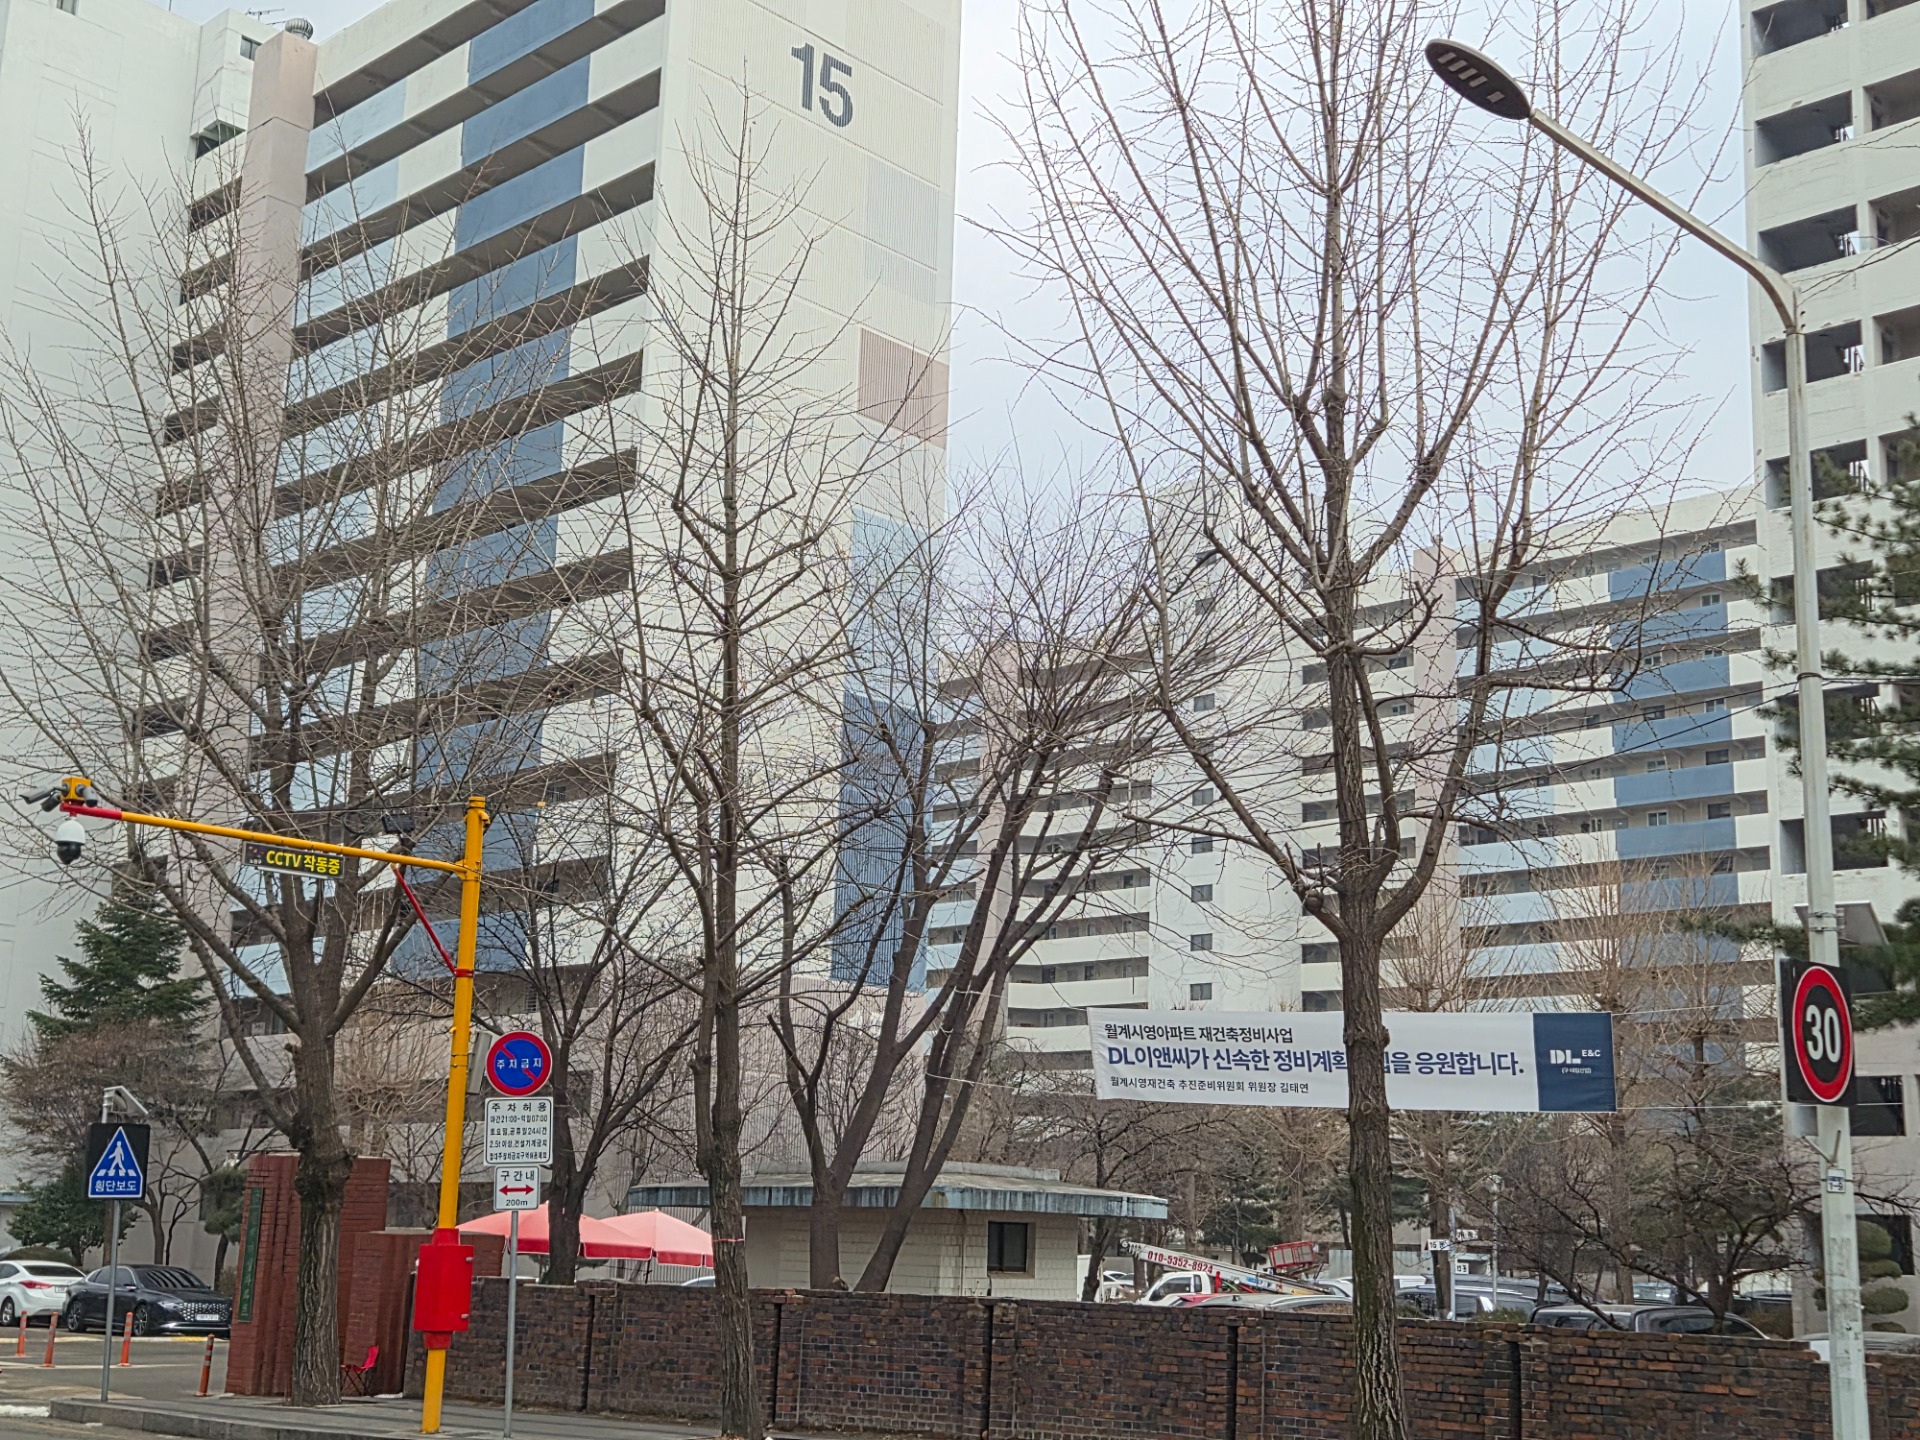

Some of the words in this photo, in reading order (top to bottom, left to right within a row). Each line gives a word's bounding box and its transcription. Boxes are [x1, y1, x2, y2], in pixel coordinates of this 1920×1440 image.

[791, 42, 853, 127] 15
[266, 850, 301, 867] CCTV
[304, 855, 340, 875] 작동중
[1105, 1023, 1197, 1041] 월계시영아파트
[1199, 1026, 1293, 1043] 재건축정비사업
[1806, 1004, 1841, 1063] 30
[1107, 1046, 1209, 1070] DL이앤씨가
[1213, 1048, 1270, 1071] 신속한
[1415, 1052, 1524, 1075] 응원합니다.
[1550, 1050, 1581, 1064] DL
[1110, 1076, 1175, 1090] 월계시영재건축
[1179, 1080, 1244, 1092] 추진준비위원회
[1248, 1081, 1276, 1093] 위원장
[95, 1180, 137, 1192] 횡단보도
[1147, 1250, 1213, 1274] 010-5352-8924
